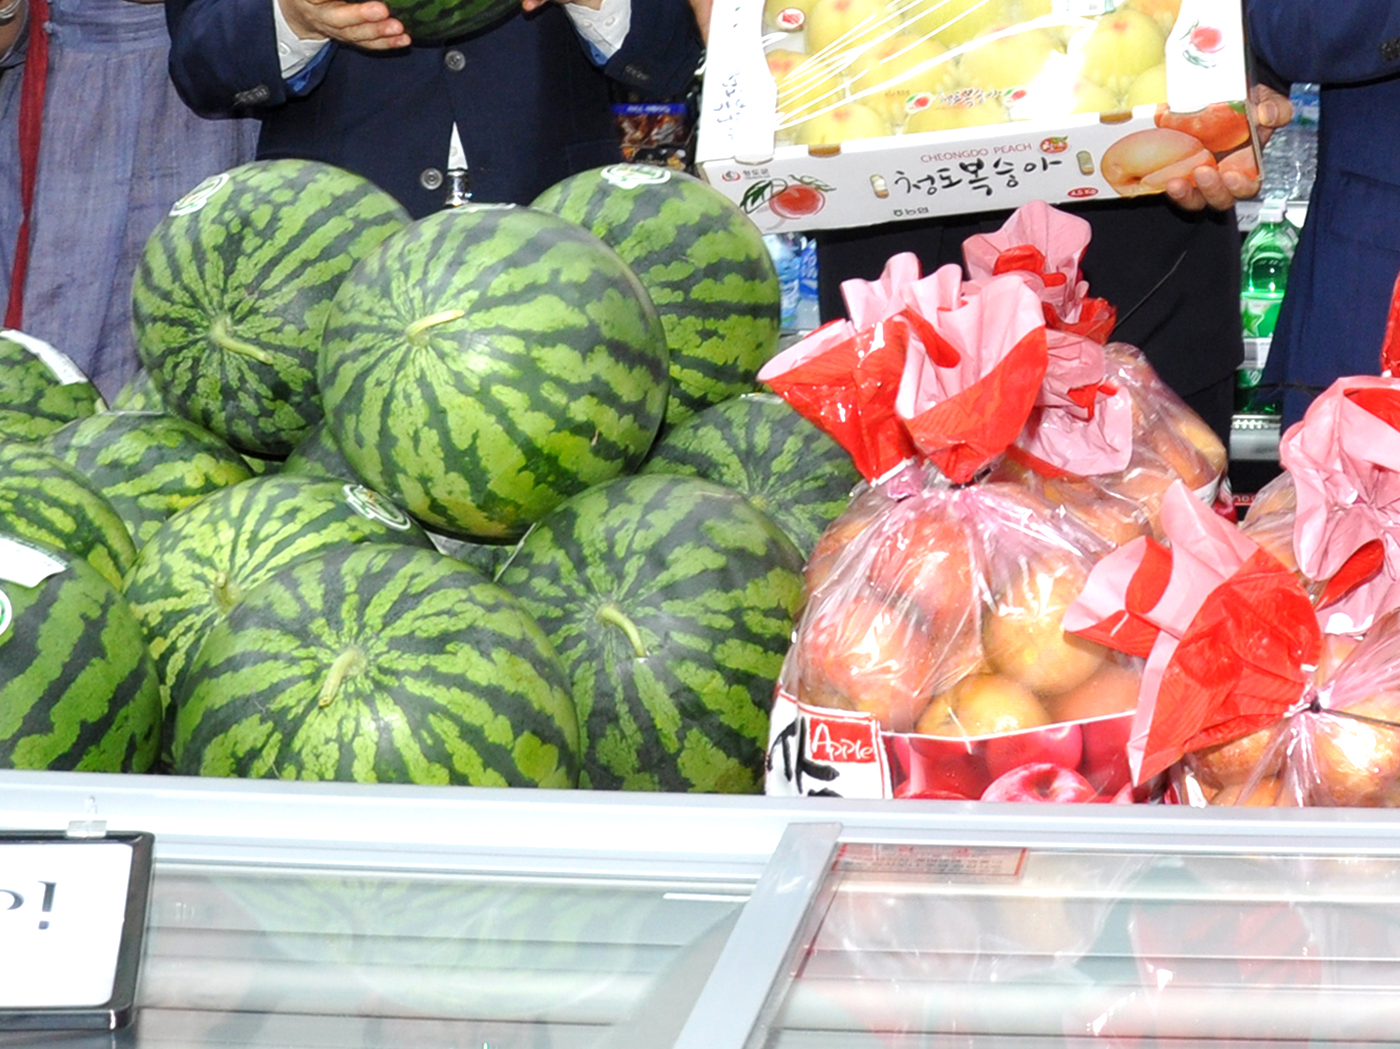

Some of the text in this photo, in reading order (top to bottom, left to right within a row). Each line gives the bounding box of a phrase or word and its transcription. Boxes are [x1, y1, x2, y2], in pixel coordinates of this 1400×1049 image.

[920, 147, 989, 163] CHEONGDO
[993, 142, 1032, 155] PEACH
[894, 157, 1063, 196] 청도복숭아
[811, 723, 876, 761] Apple
